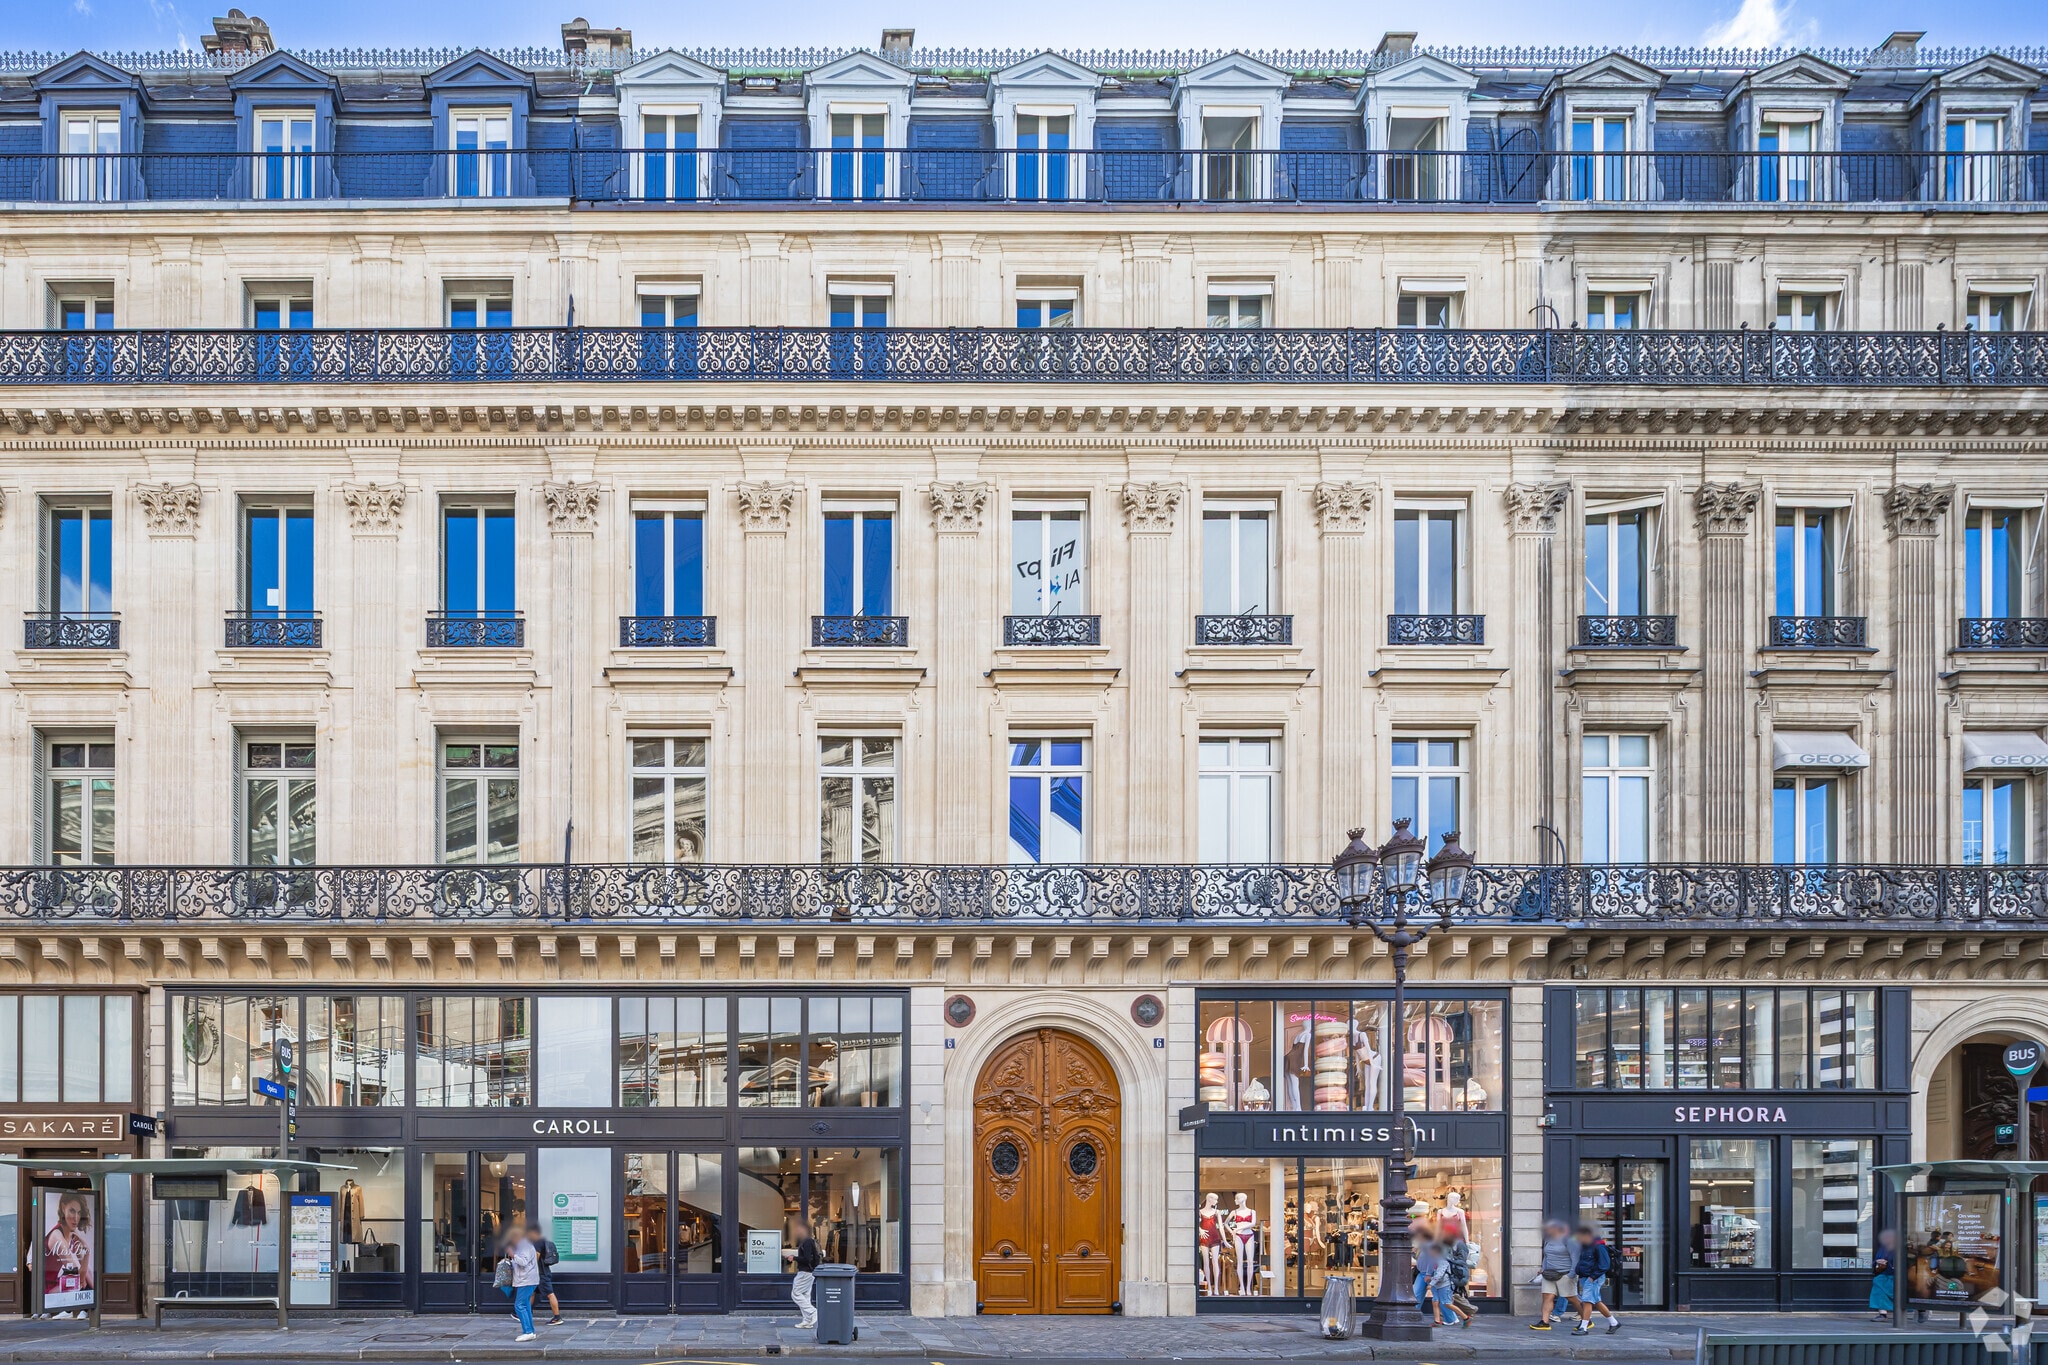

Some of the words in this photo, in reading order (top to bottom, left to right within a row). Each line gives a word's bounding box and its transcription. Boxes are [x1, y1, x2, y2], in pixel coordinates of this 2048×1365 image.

[1799, 753, 1860, 765] GEOX
[1990, 754, 2048, 766] GEOX
[947, 1040, 953, 1049] 6
[1156, 1038, 1163, 1048] 6
[281, 1046, 292, 1060] BUS
[2008, 1047, 2036, 1062] BUS
[1674, 1106, 1788, 1123] SEPHORA
[3, 1118, 114, 1133] SAKARÉ
[132, 1120, 154, 1131] CAROLL
[532, 1119, 615, 1134] CAROLL
[1999, 1127, 2013, 1135] 66
[1272, 1124, 1436, 1142] intimissi
[75, 1292, 91, 1301] DIOR
